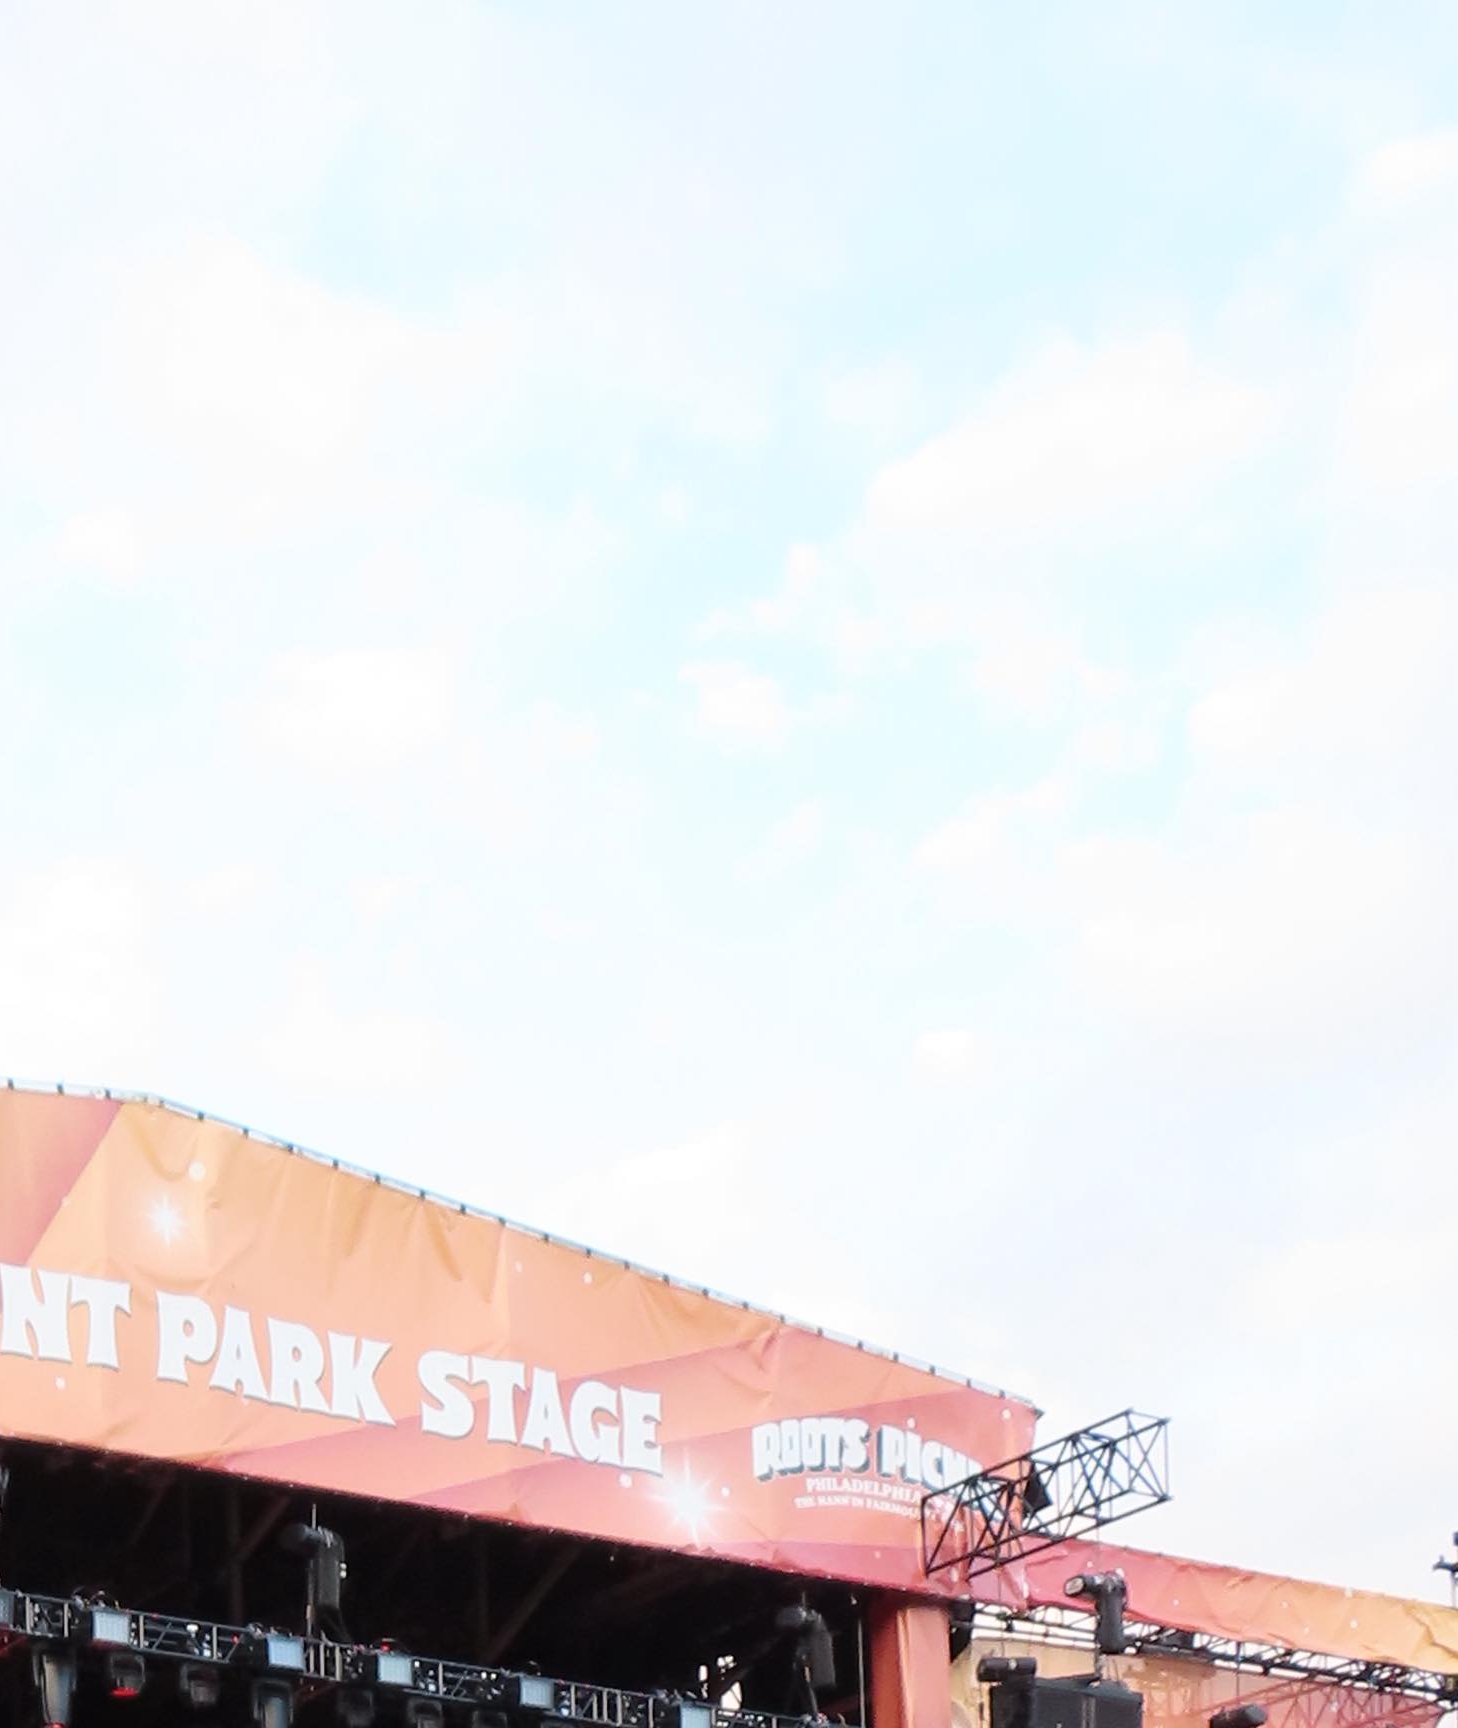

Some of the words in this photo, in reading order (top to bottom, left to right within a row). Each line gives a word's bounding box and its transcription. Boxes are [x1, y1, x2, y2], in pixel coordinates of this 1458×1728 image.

[155, 1290, 397, 1427] PARK
[418, 1350, 664, 1477] STAGE
[752, 1417, 871, 1482] ROOTS
